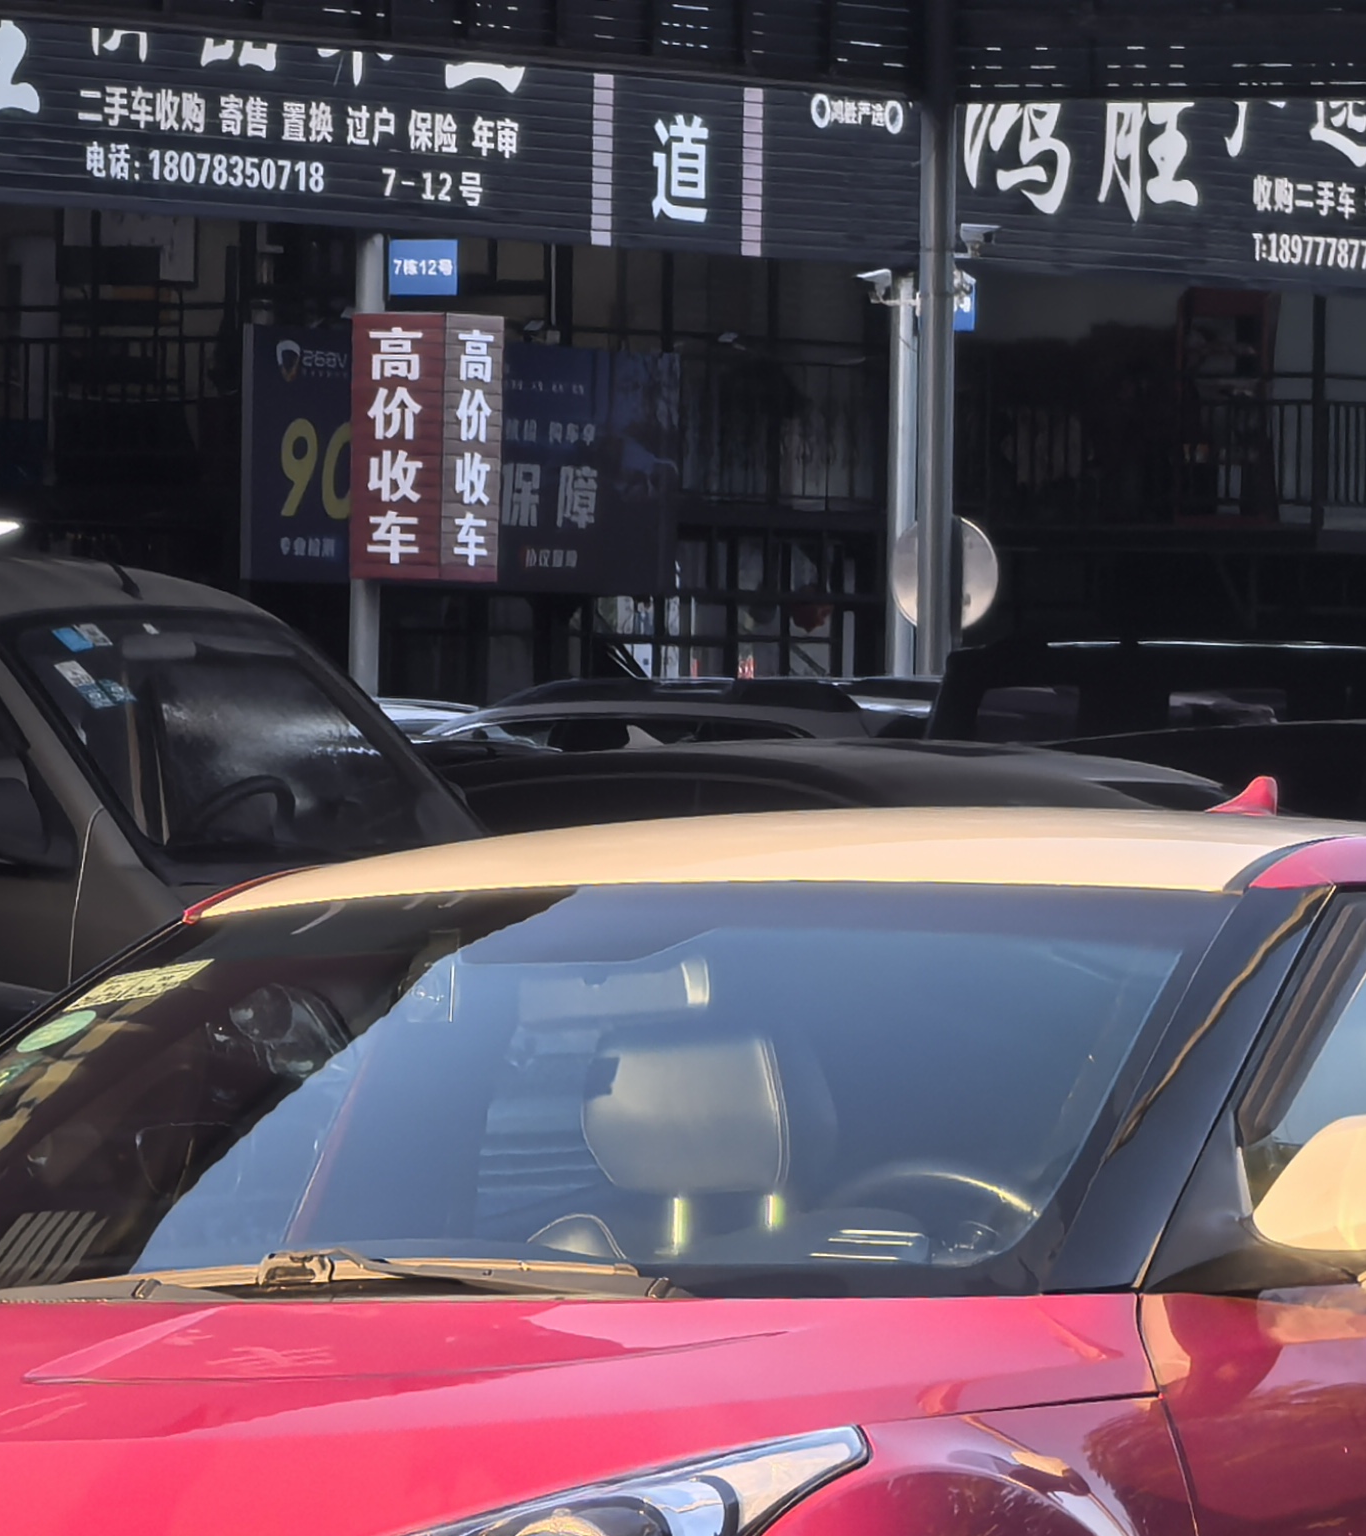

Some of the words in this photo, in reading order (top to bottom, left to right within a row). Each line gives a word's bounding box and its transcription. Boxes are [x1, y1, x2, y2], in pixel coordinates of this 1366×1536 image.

[78, 87, 205, 132] 二手车收购
[218, 94, 268, 139] 寄售
[282, 101, 333, 143] 置换
[347, 105, 396, 146] 过户
[408, 110, 457, 154] 保险
[471, 117, 519, 159] 年审
[149, 149, 325, 193] 18078350718
[652, 115, 709, 223] 道
[1253, 175, 1356, 220] 收购二手车
[366, 327, 423, 565] 高价收车
[452, 329, 495, 567] 高价收车
